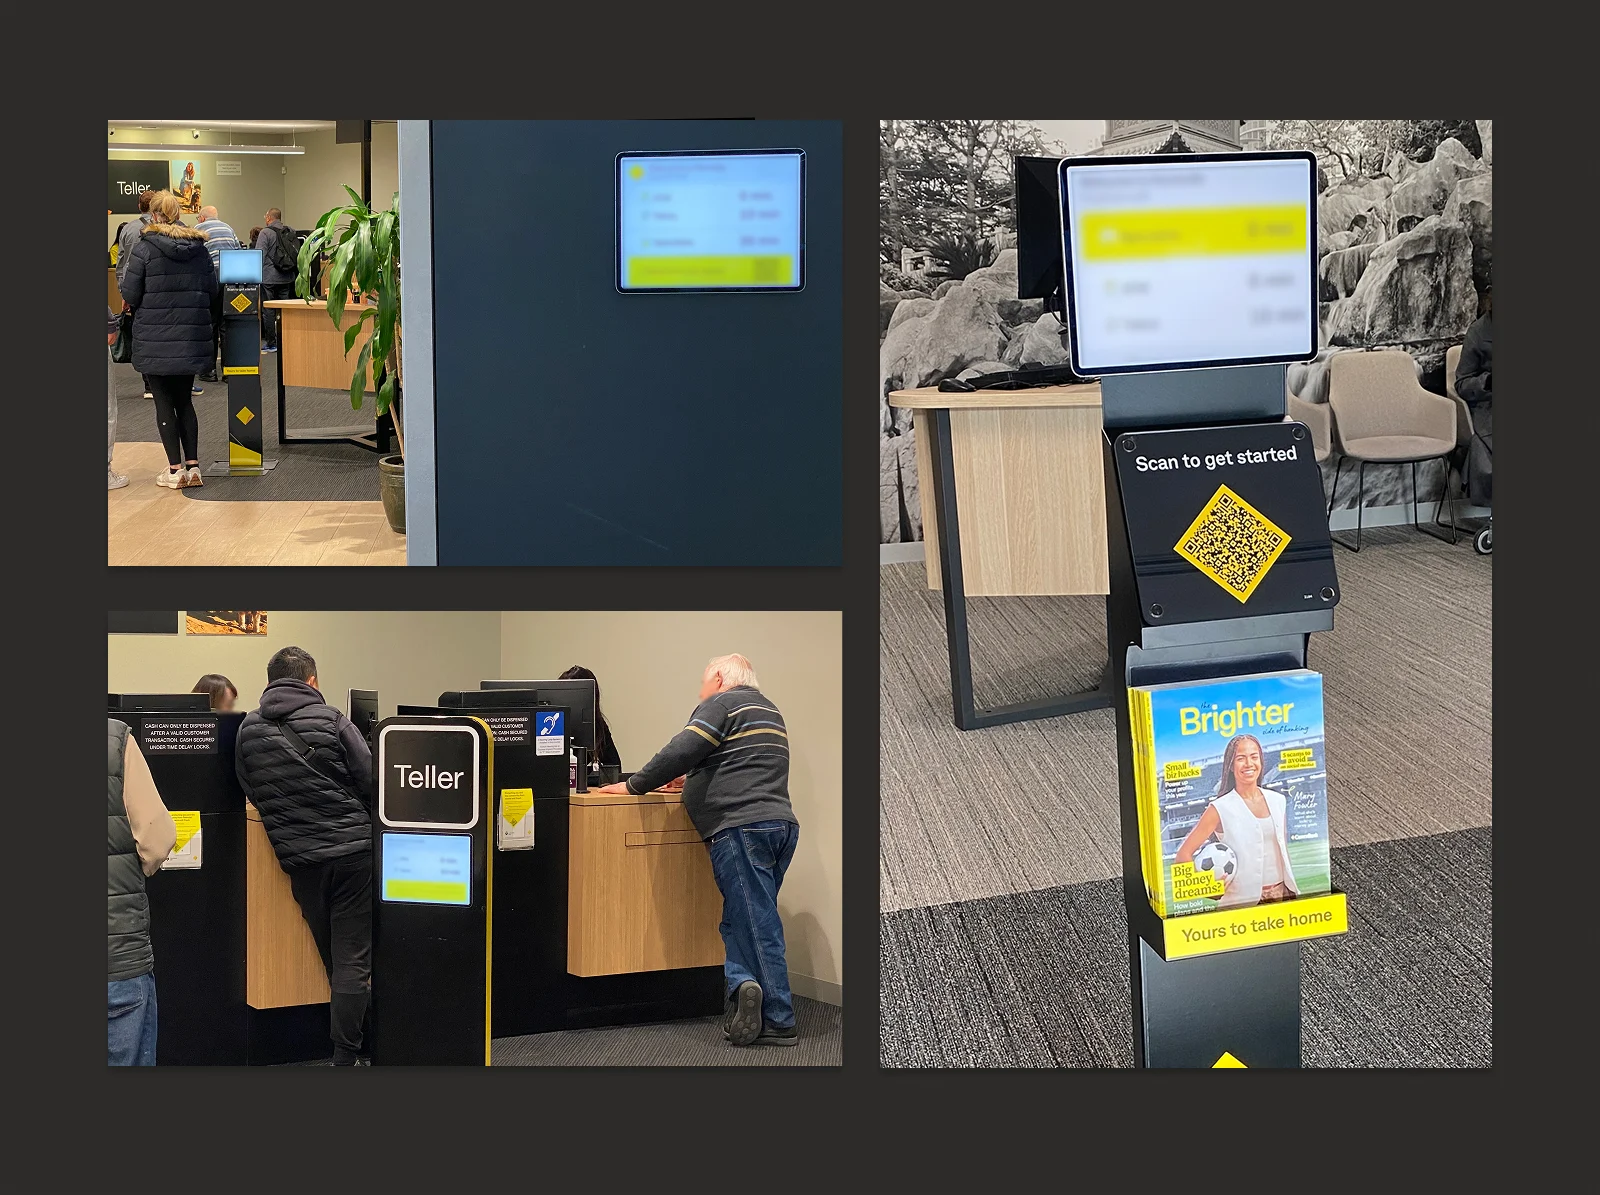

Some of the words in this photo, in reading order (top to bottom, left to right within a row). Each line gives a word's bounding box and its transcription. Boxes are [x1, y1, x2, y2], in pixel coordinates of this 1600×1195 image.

[117, 181, 151, 195] Teller
[1135, 455, 1178, 472] Scan
[1182, 454, 1200, 468] to
[1204, 451, 1233, 471] get
[1238, 445, 1298, 464] started
[1180, 701, 1294, 737] Brighter
[1284, 725, 1309, 734] banking
[1166, 762, 1186, 771] Small
[1178, 769, 1199, 777] hacks
[394, 764, 464, 789] Teller
[1294, 792, 1315, 802] Mary
[1294, 800, 1318, 810] Fowler
[1174, 865, 1192, 878] Big
[1174, 875, 1212, 888] money
[1175, 882, 1222, 899] dreams?
[1182, 926, 1226, 943] Yours
[1230, 923, 1246, 936] to
[1250, 917, 1285, 933] take
[1289, 910, 1333, 927] home
